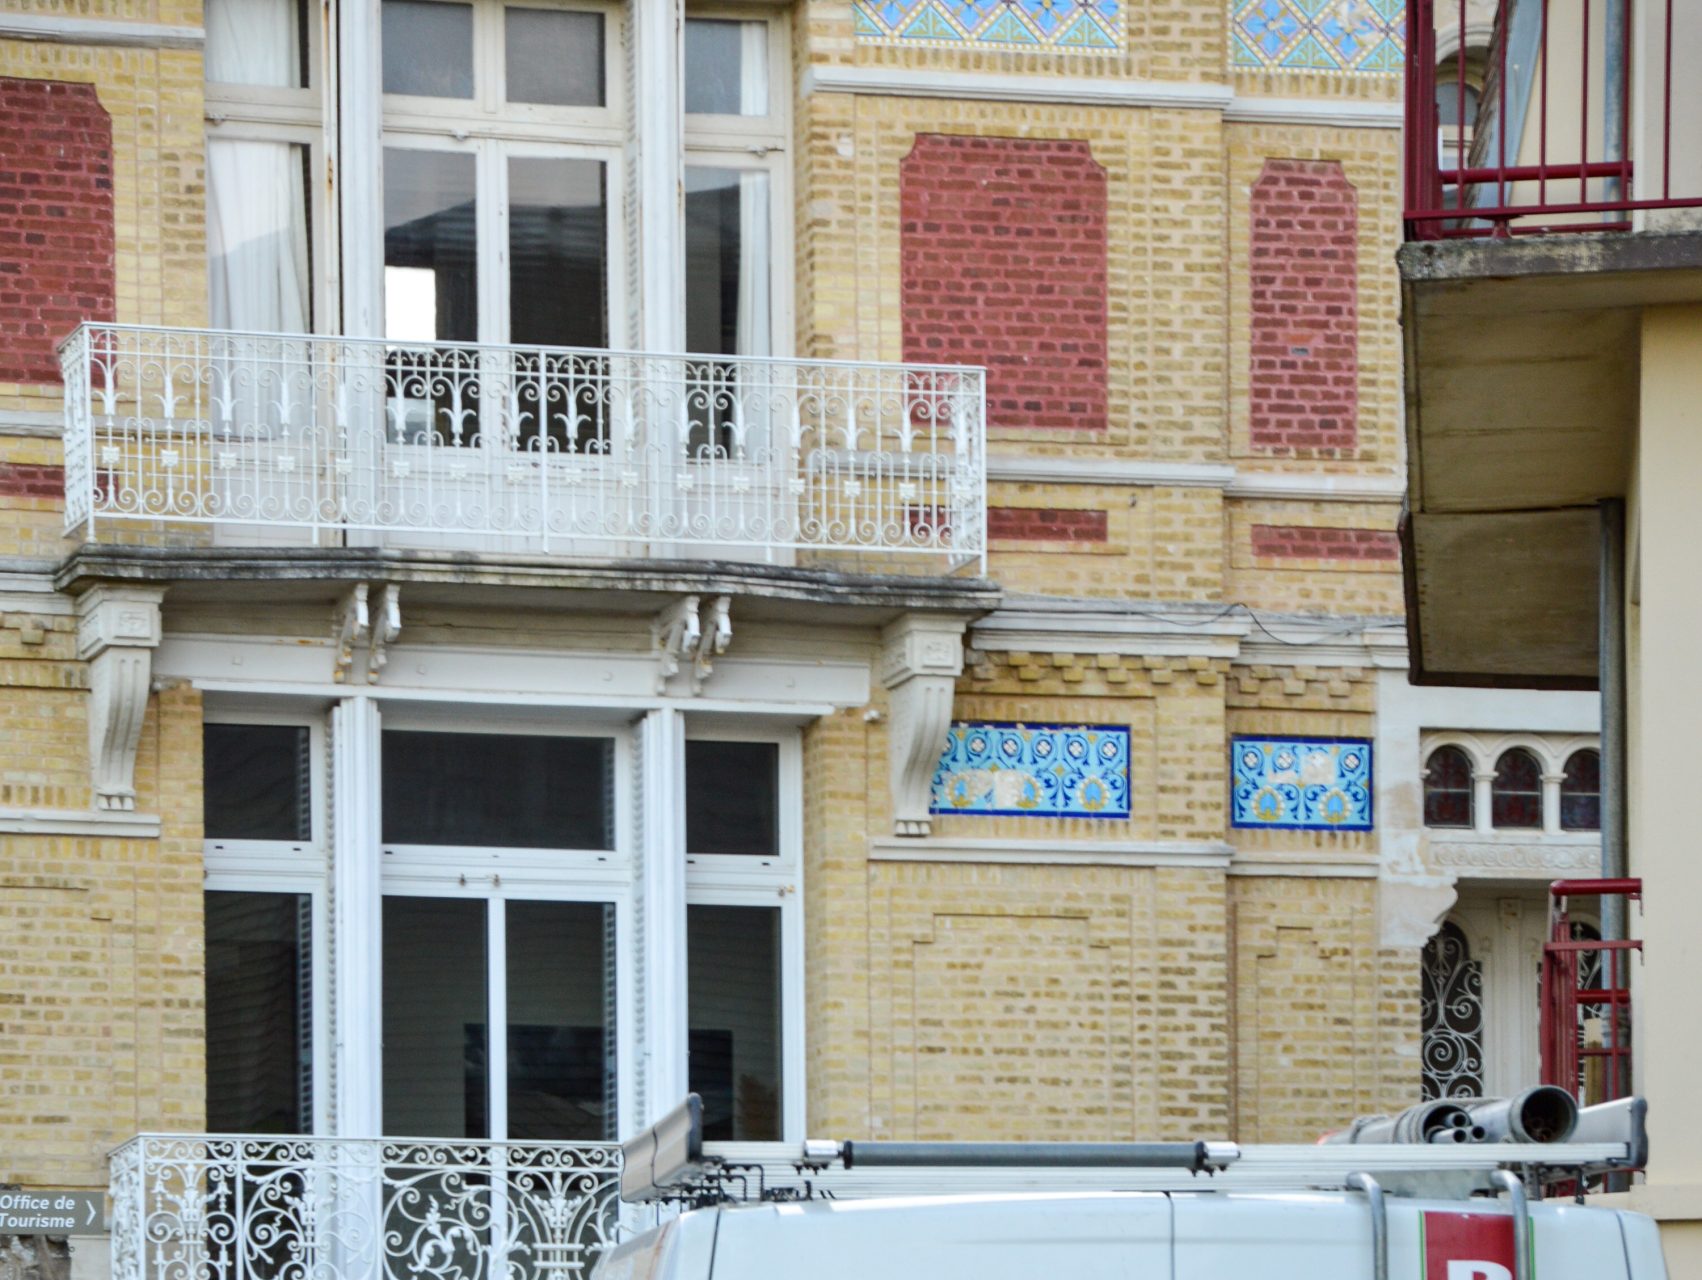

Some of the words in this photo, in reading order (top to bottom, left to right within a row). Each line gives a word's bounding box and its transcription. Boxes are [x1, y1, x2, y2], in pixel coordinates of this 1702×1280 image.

[0, 1194, 50, 1209] Office
[54, 1195, 75, 1209] de
[0, 1213, 75, 1228] Tourisme
